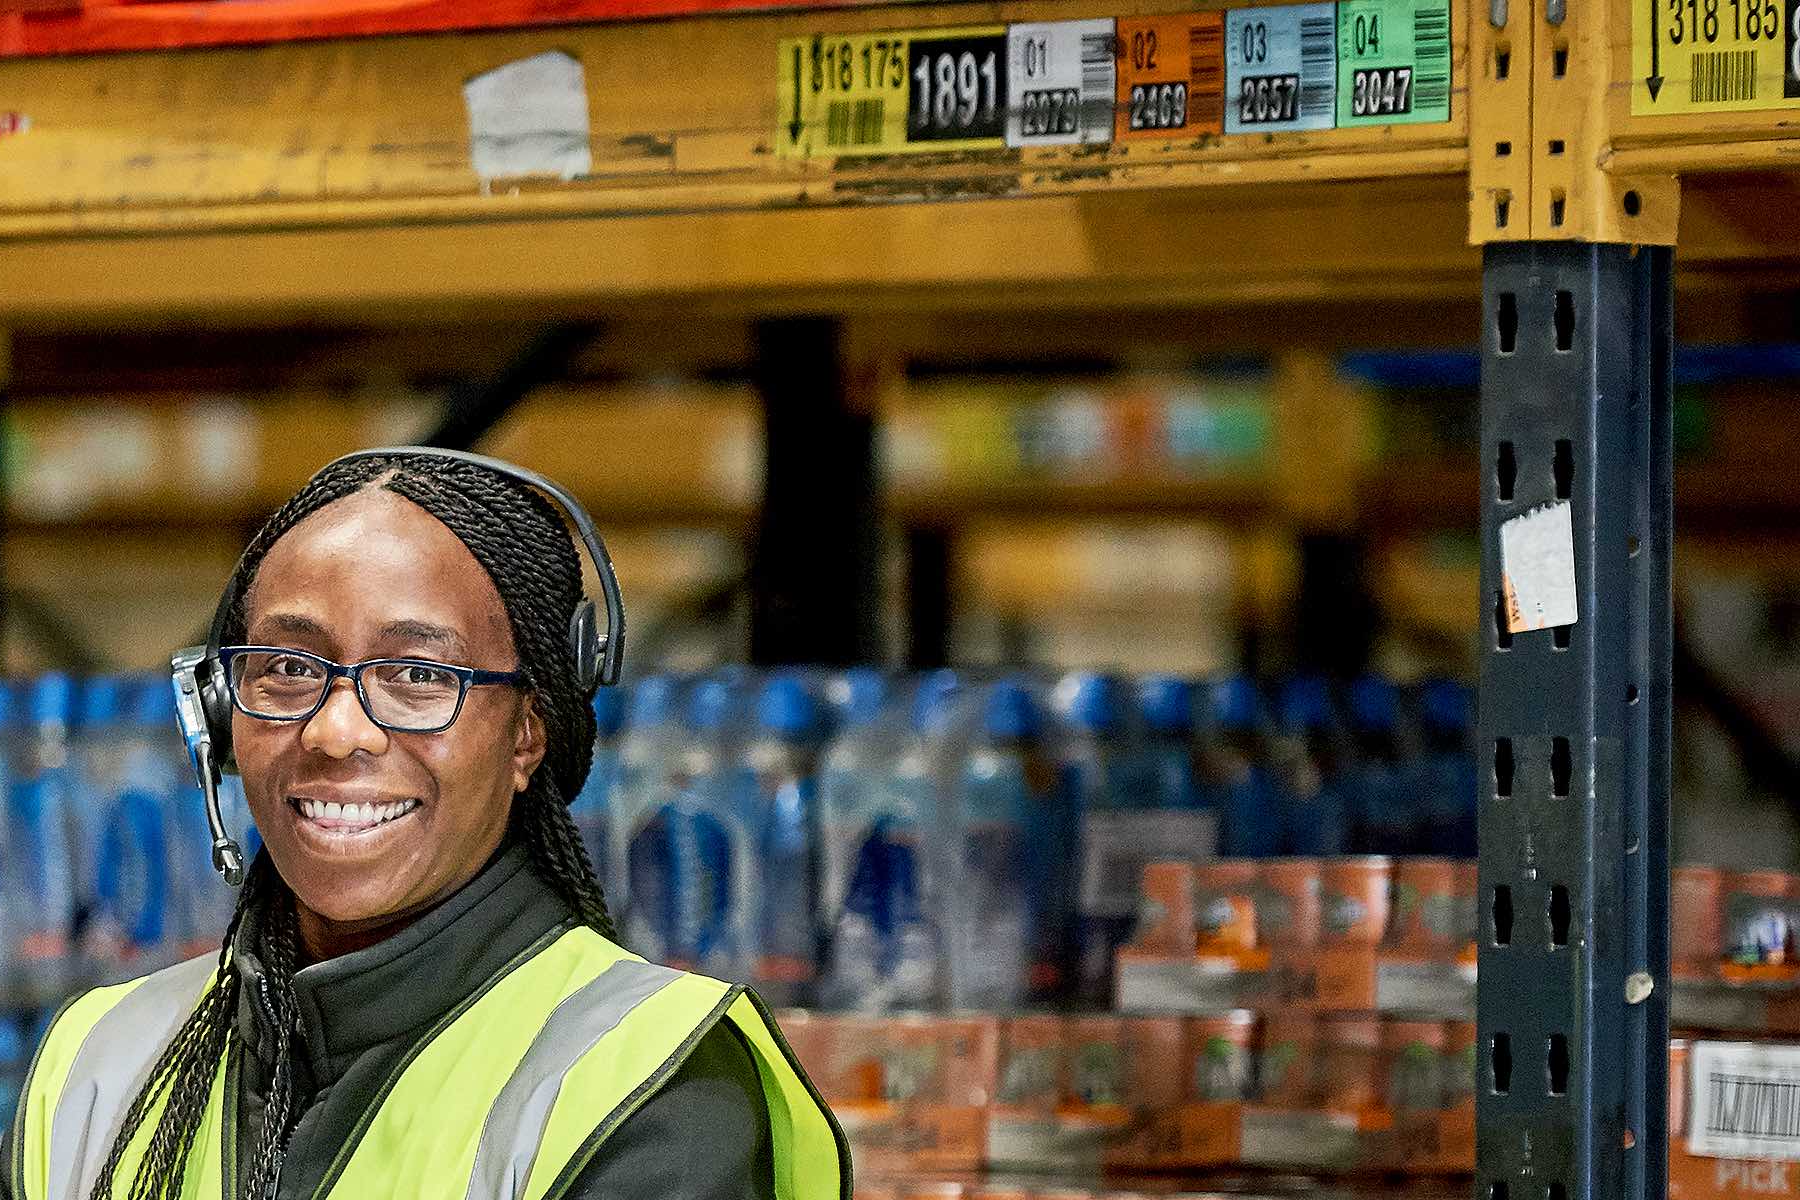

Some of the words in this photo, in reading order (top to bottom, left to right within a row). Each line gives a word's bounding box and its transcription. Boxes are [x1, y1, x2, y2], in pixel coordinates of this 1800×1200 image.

[1243, 21, 1268, 63] 03
[1355, 14, 1380, 56] 04
[1669, 0, 1719, 45] 318
[1729, 0, 1779, 41] 185
[1026, 37, 1048, 78] 01
[1133, 29, 1158, 70] 02
[913, 50, 997, 128] 1891
[1242, 77, 1298, 121] 2657
[1354, 69, 1412, 116] 3047
